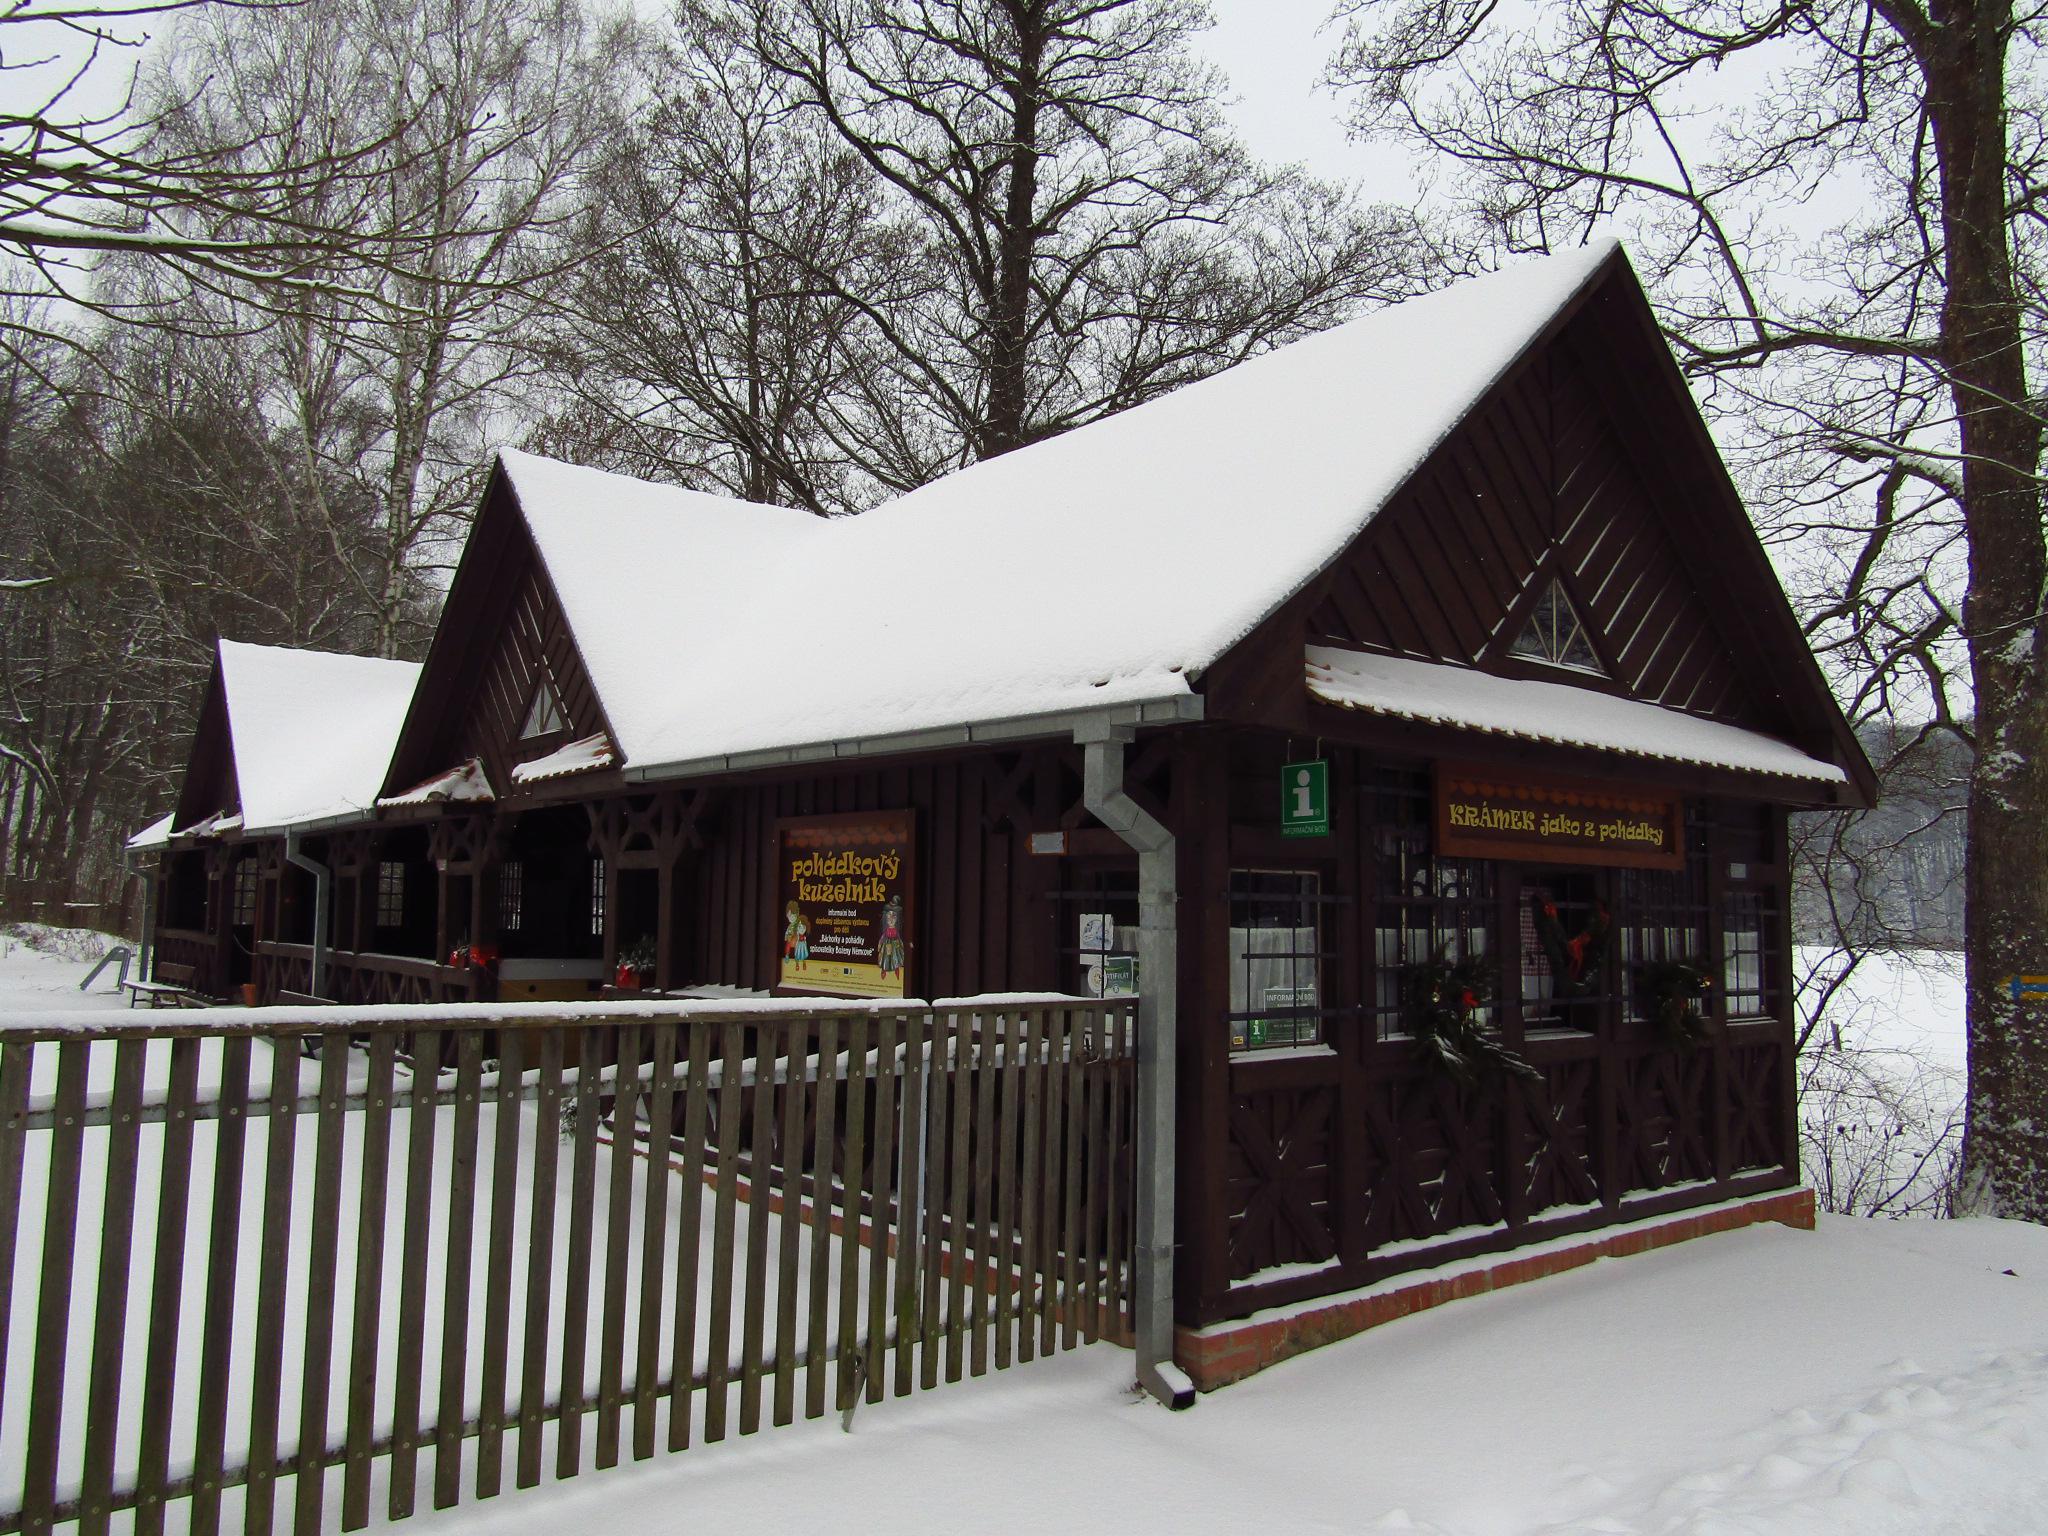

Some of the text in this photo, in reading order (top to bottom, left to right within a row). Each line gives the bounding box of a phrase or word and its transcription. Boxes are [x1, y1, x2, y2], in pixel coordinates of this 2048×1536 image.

[1448, 800, 1535, 832] KRÁMEK
[1539, 812, 1580, 836] jako
[1599, 819, 1664, 846] pohádky
[792, 849, 900, 882] pohádkový
[798, 877, 886, 904] kuželník
